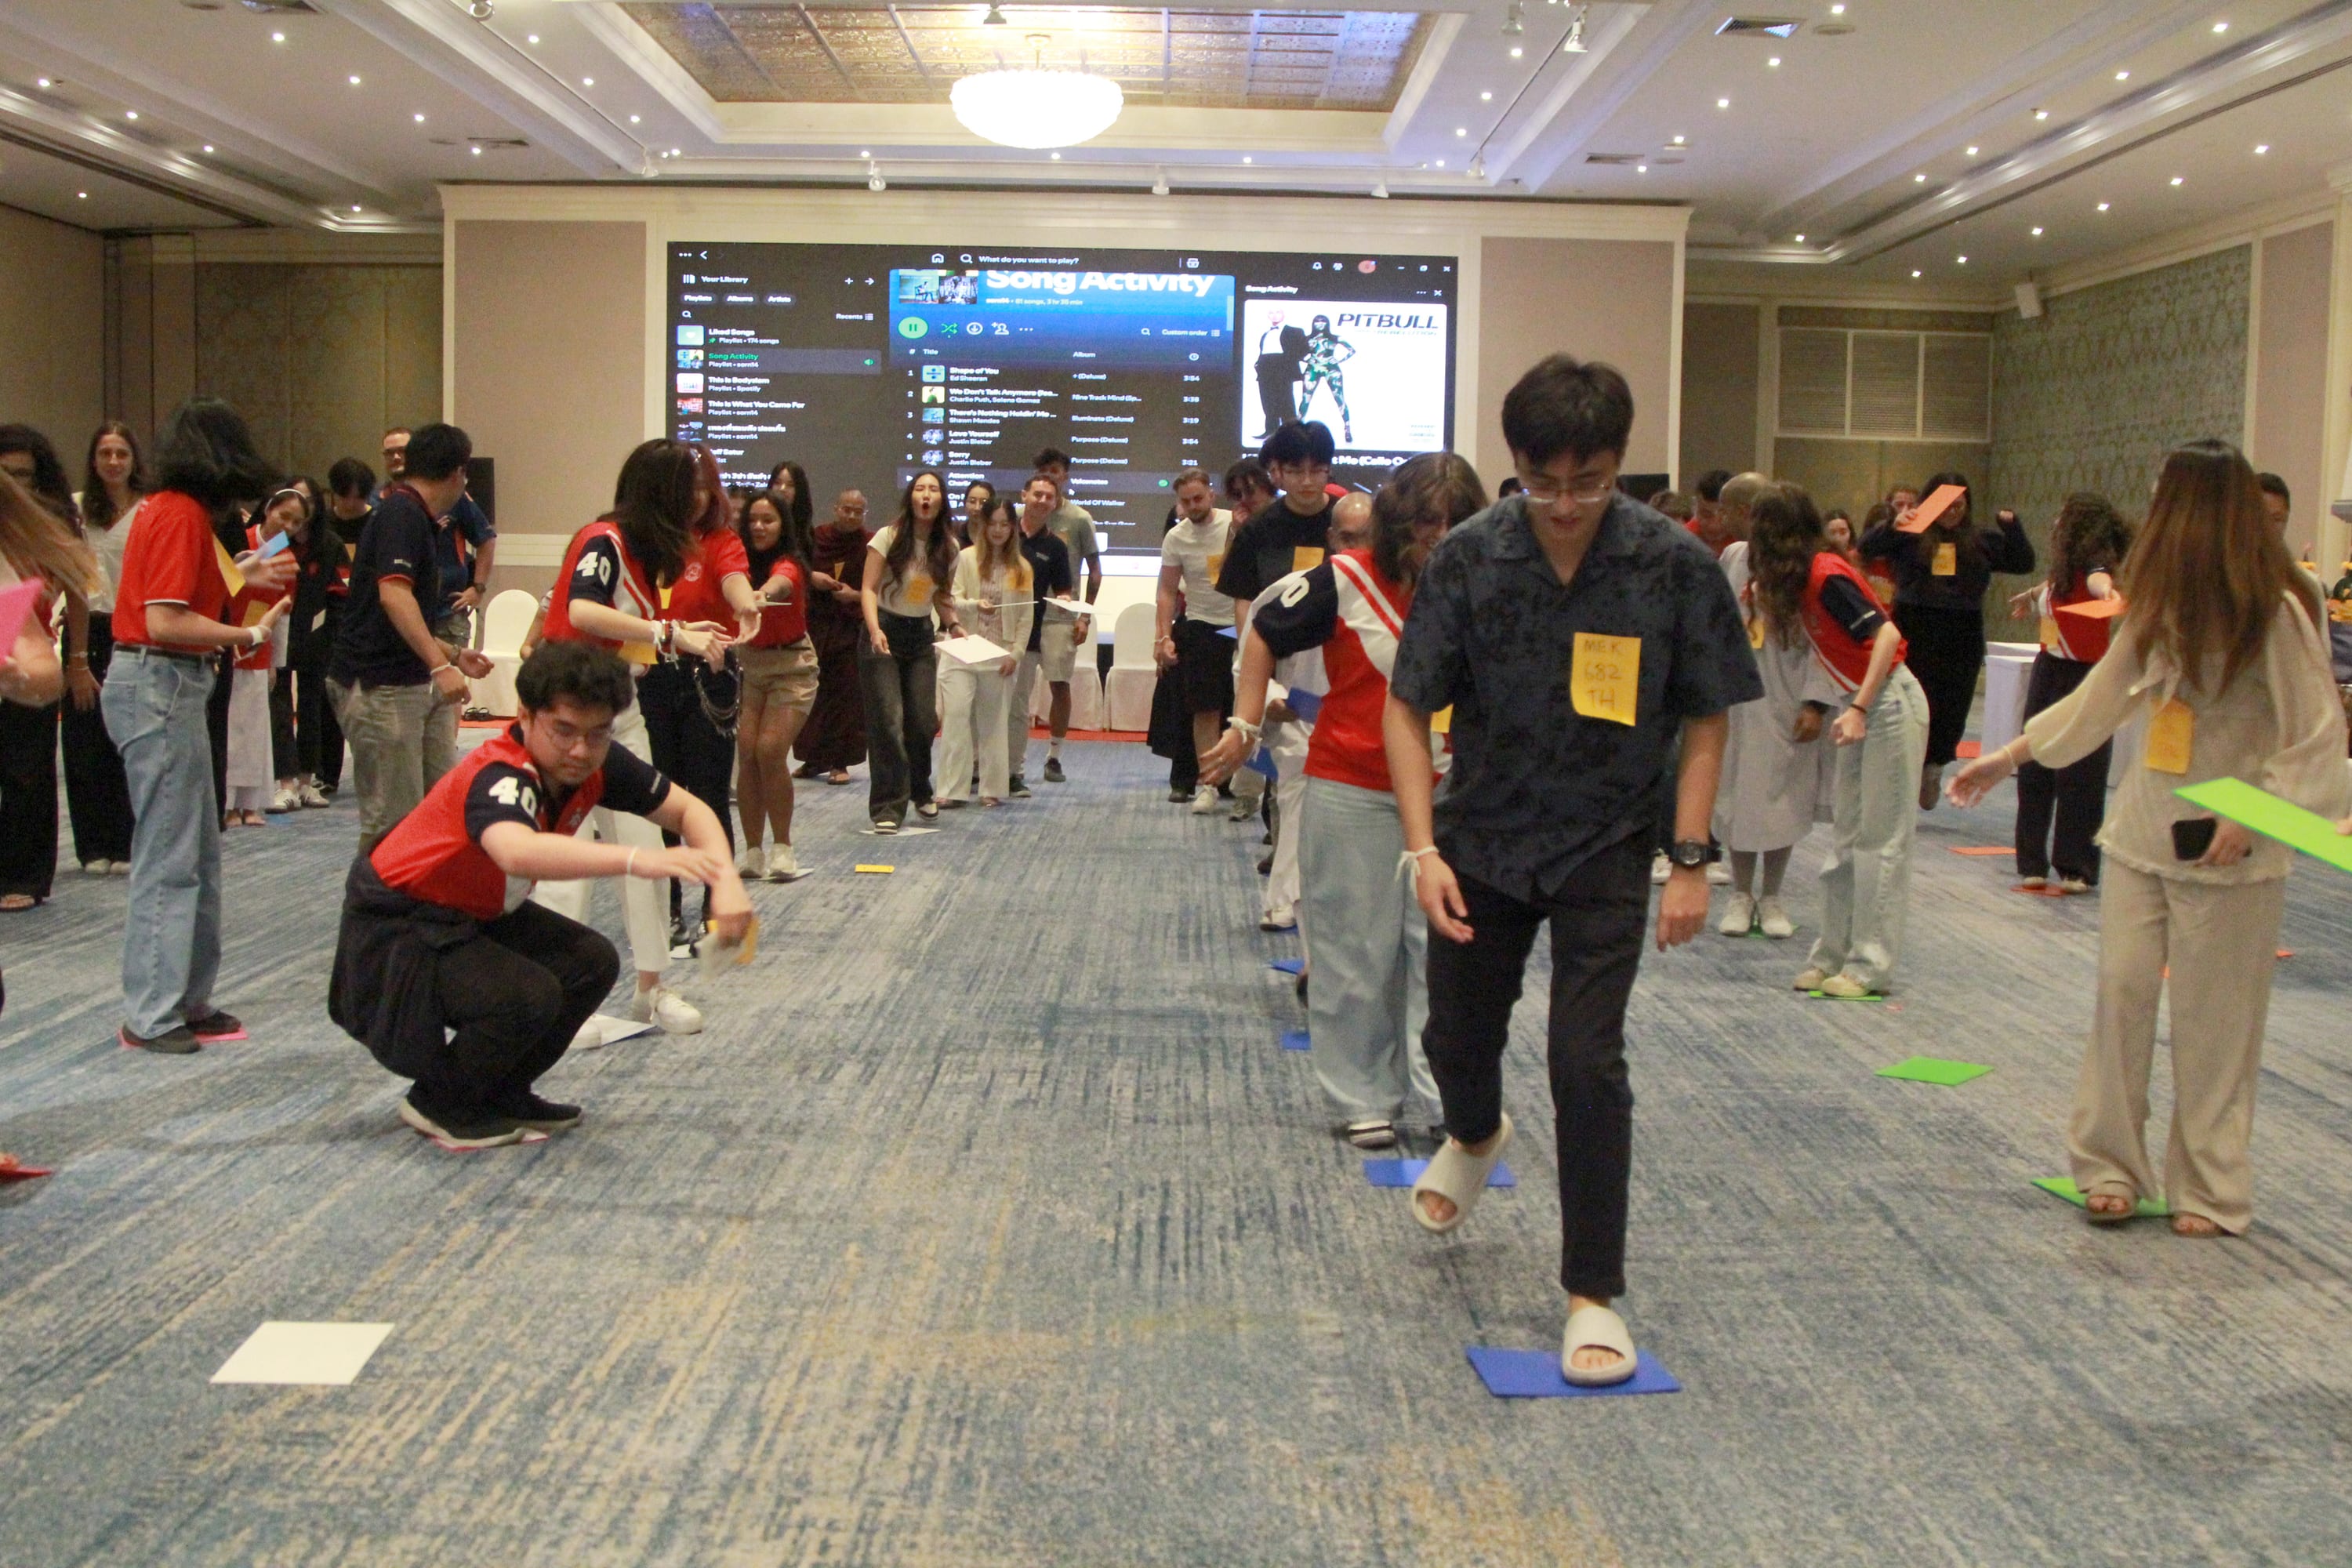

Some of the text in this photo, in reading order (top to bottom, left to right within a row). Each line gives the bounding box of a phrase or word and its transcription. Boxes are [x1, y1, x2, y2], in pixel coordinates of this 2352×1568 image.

[720, 276, 749, 284] Library
[986, 270, 1216, 297] Song Activity
[1268, 286, 1298, 294] Activity
[1338, 314, 1439, 329] PITBULL
[731, 328, 755, 337] Songs
[730, 353, 759, 361] Activity
[977, 410, 1009, 418] Nothing
[948, 451, 971, 459] Sorry
[1339, 456, 1359, 465] Me
[575, 551, 612, 586] 40
[488, 776, 538, 820] 40
